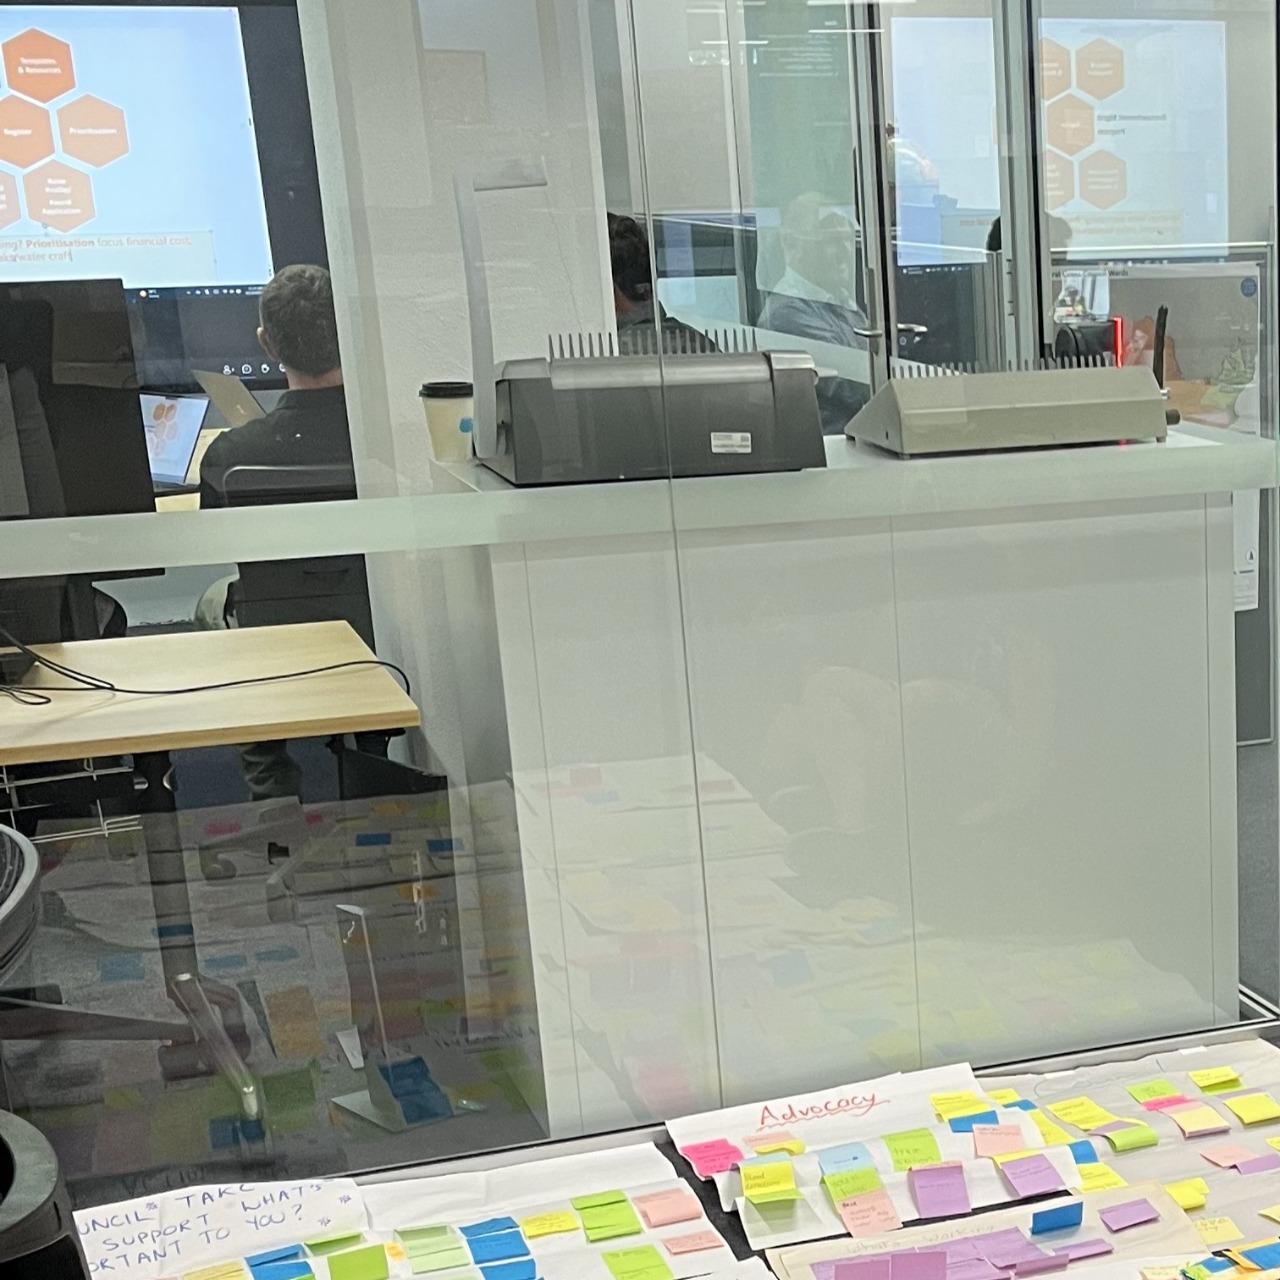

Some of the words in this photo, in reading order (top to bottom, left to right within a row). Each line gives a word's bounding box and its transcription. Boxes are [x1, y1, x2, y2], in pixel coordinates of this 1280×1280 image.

[26, 238, 95, 249] Prioritisation
[760, 1093, 878, 1125] Advocacy
[102, 1214, 211, 1252] SUPPORT
[240, 1183, 323, 1212] WHAT'S
[198, 1228, 231, 1244] TO
[244, 1204, 303, 1231] YOU?
